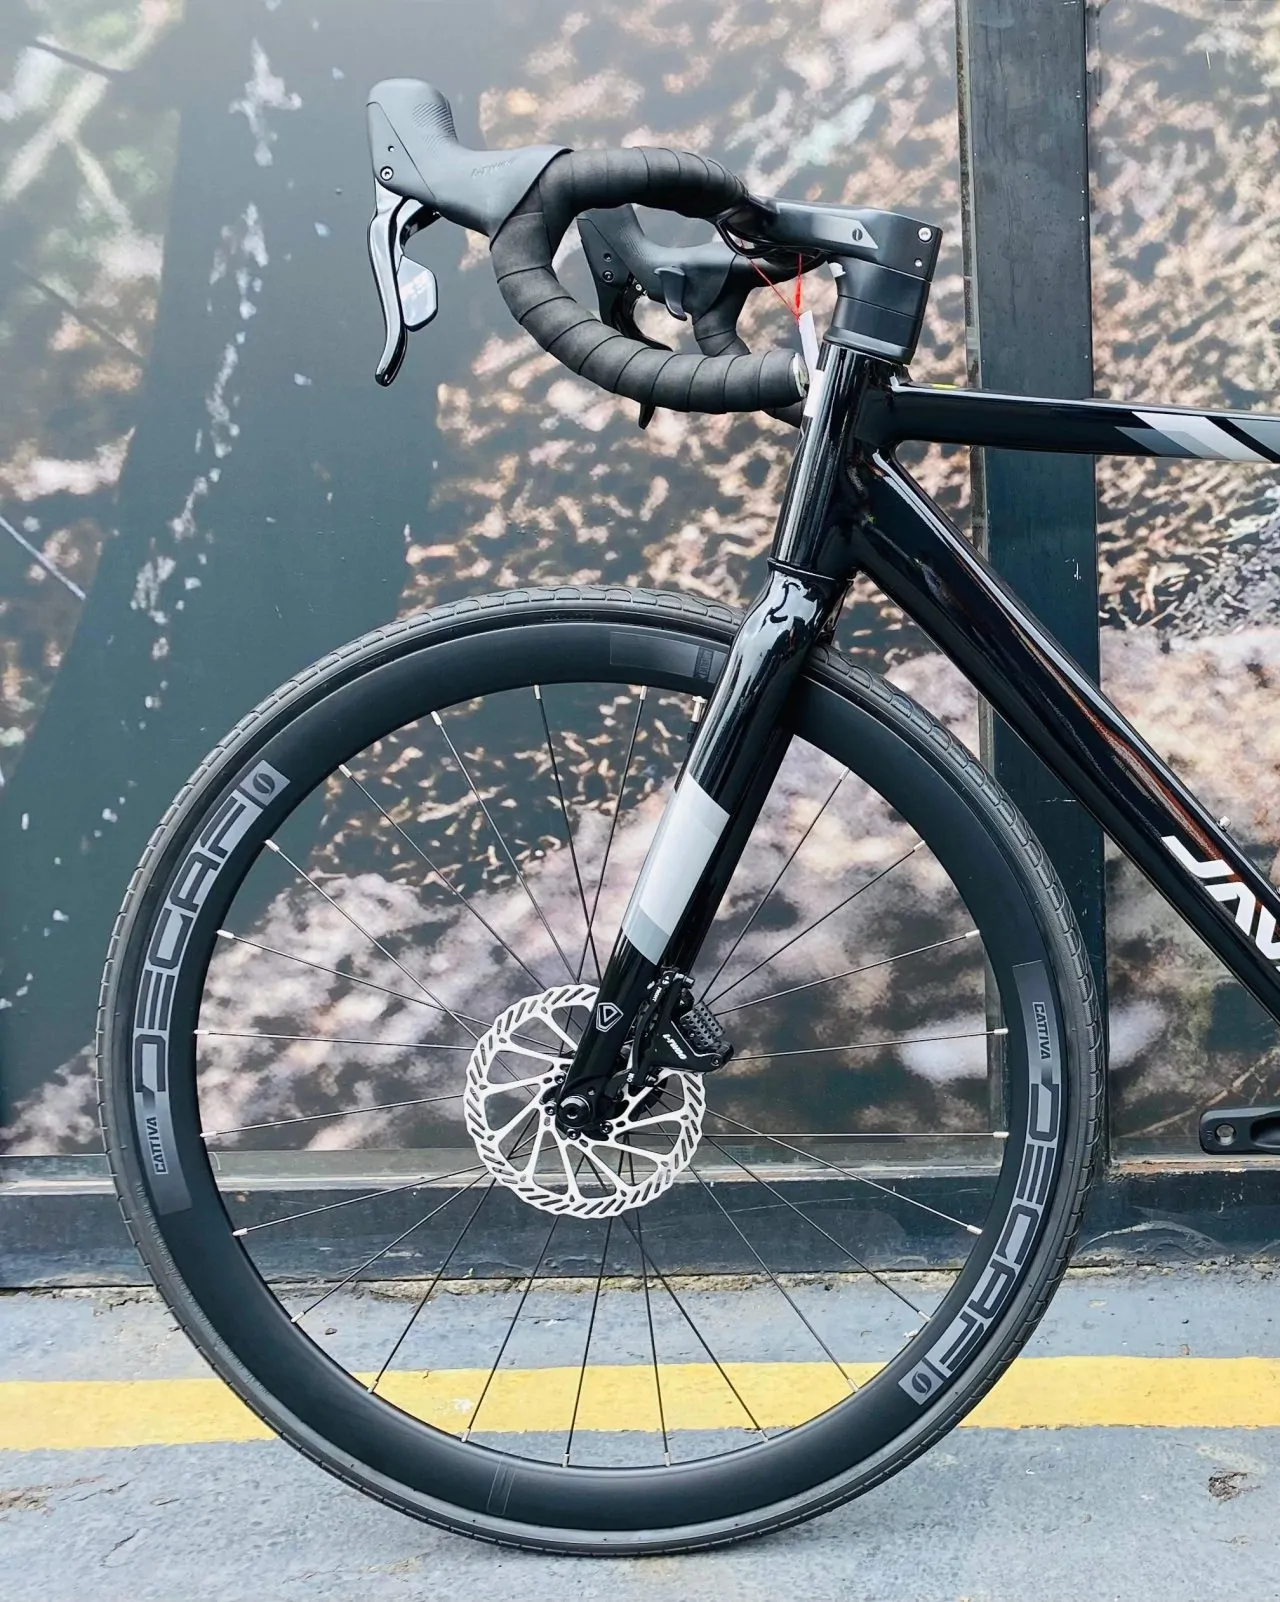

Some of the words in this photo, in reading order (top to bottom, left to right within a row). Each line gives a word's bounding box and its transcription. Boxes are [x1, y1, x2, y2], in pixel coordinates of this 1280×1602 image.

[135, 793, 250, 1109] DECAF
[1032, 1002, 1051, 1060] CATTIVA
[143, 1117, 169, 1175] CATTIVA
[941, 1070, 1060, 1372] DECAF
